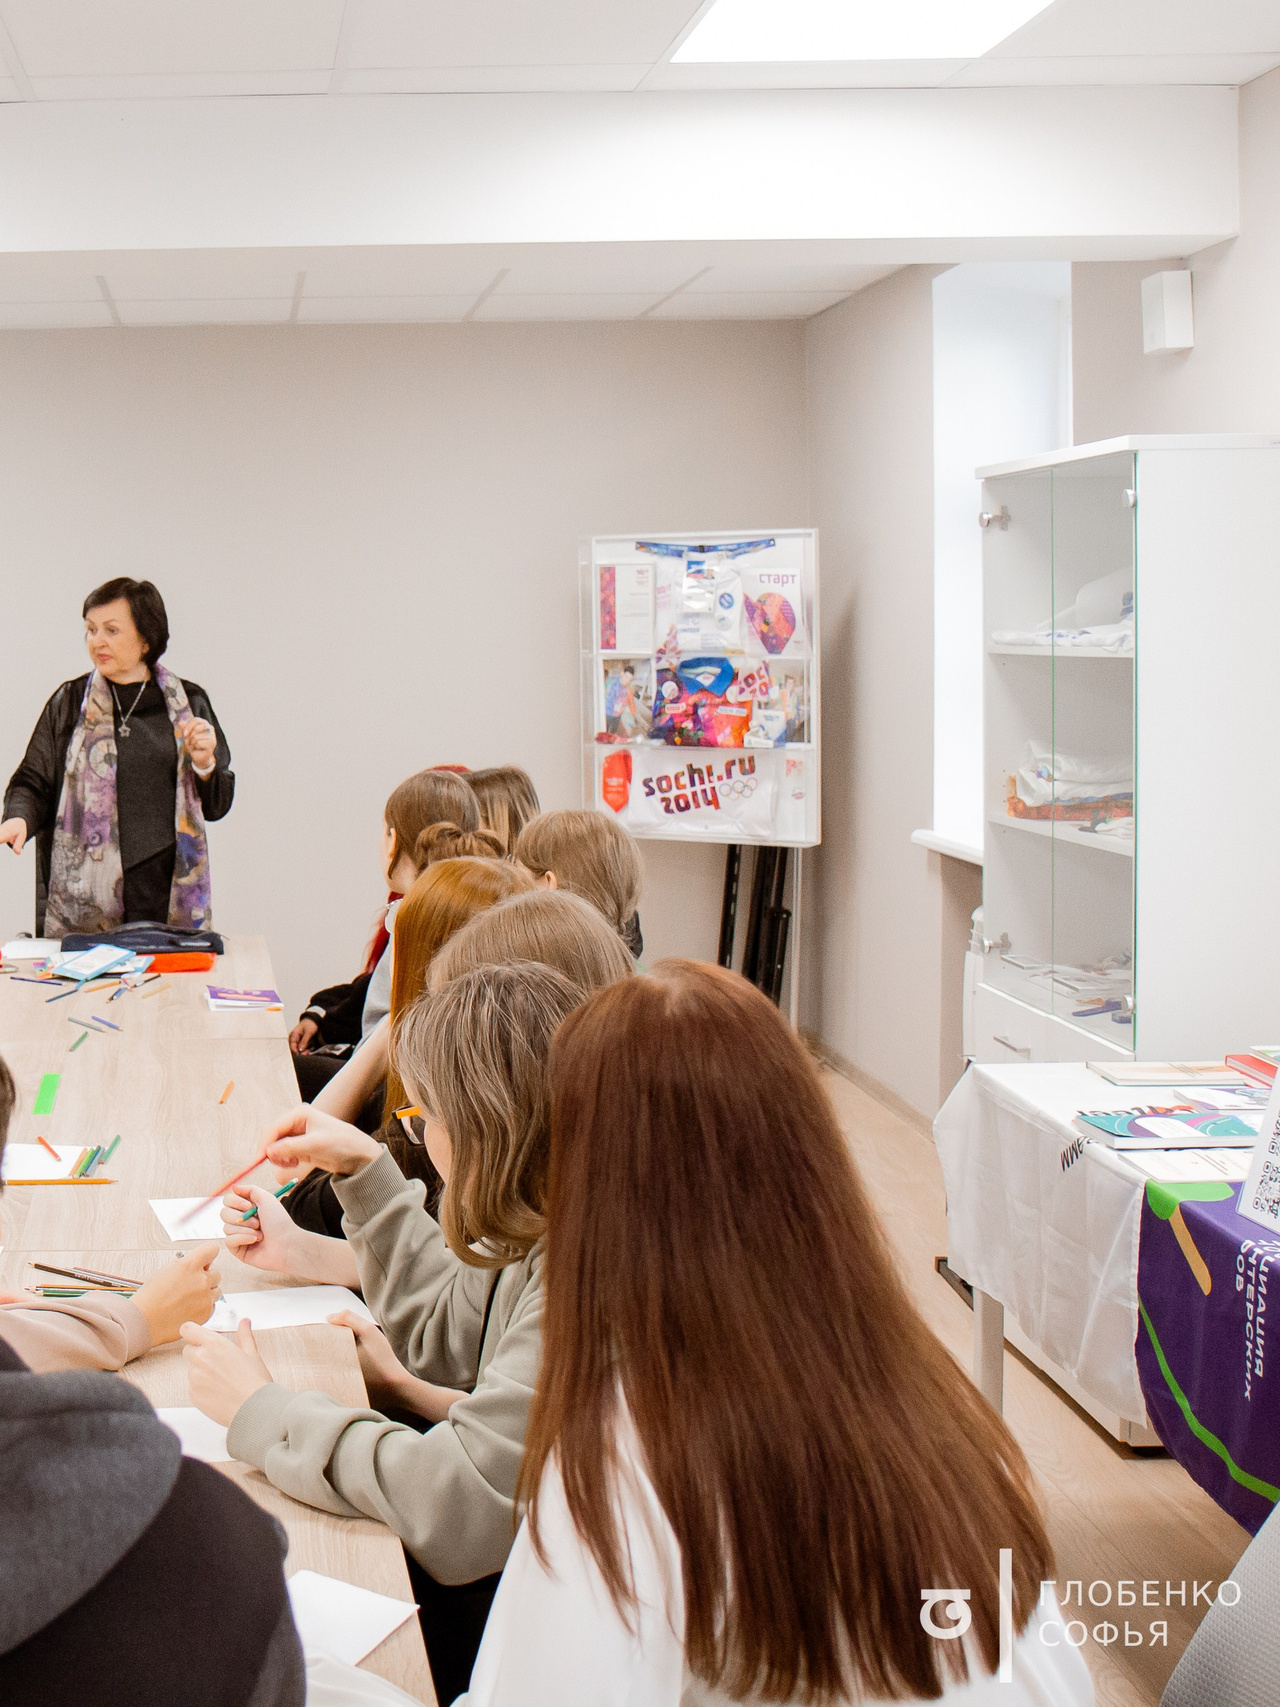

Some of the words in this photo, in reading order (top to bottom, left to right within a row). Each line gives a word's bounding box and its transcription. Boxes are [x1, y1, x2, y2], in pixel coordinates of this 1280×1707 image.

[759, 573, 797, 587] старт
[642, 755, 756, 797] sochi.ru
[660, 786, 721, 814] 2014
